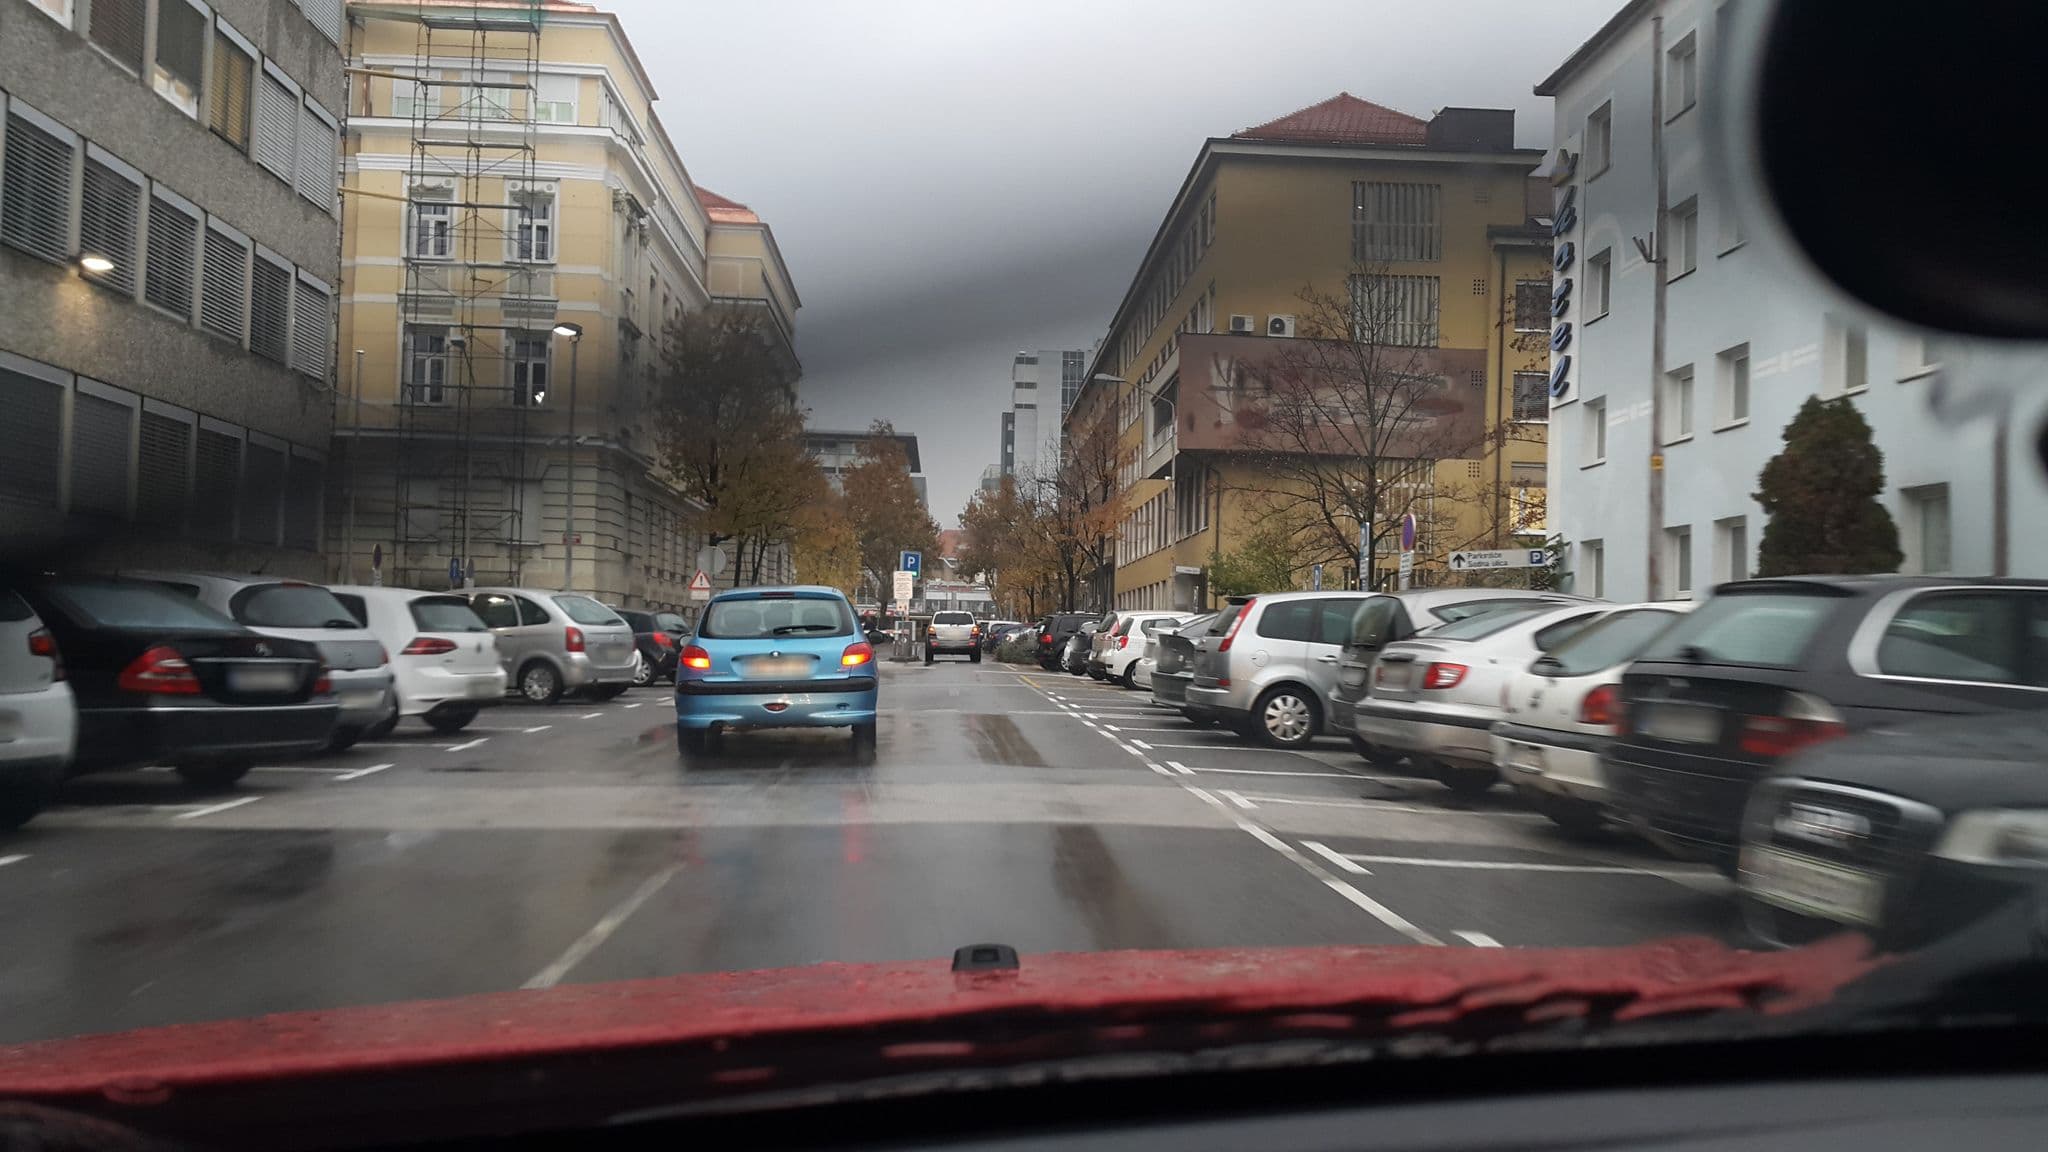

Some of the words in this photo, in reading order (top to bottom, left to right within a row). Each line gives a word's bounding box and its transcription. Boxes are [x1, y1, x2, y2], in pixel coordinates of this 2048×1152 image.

[1548, 185, 1578, 398] hotel
[907, 556, 916, 568] P
[1532, 553, 1541, 562] P
